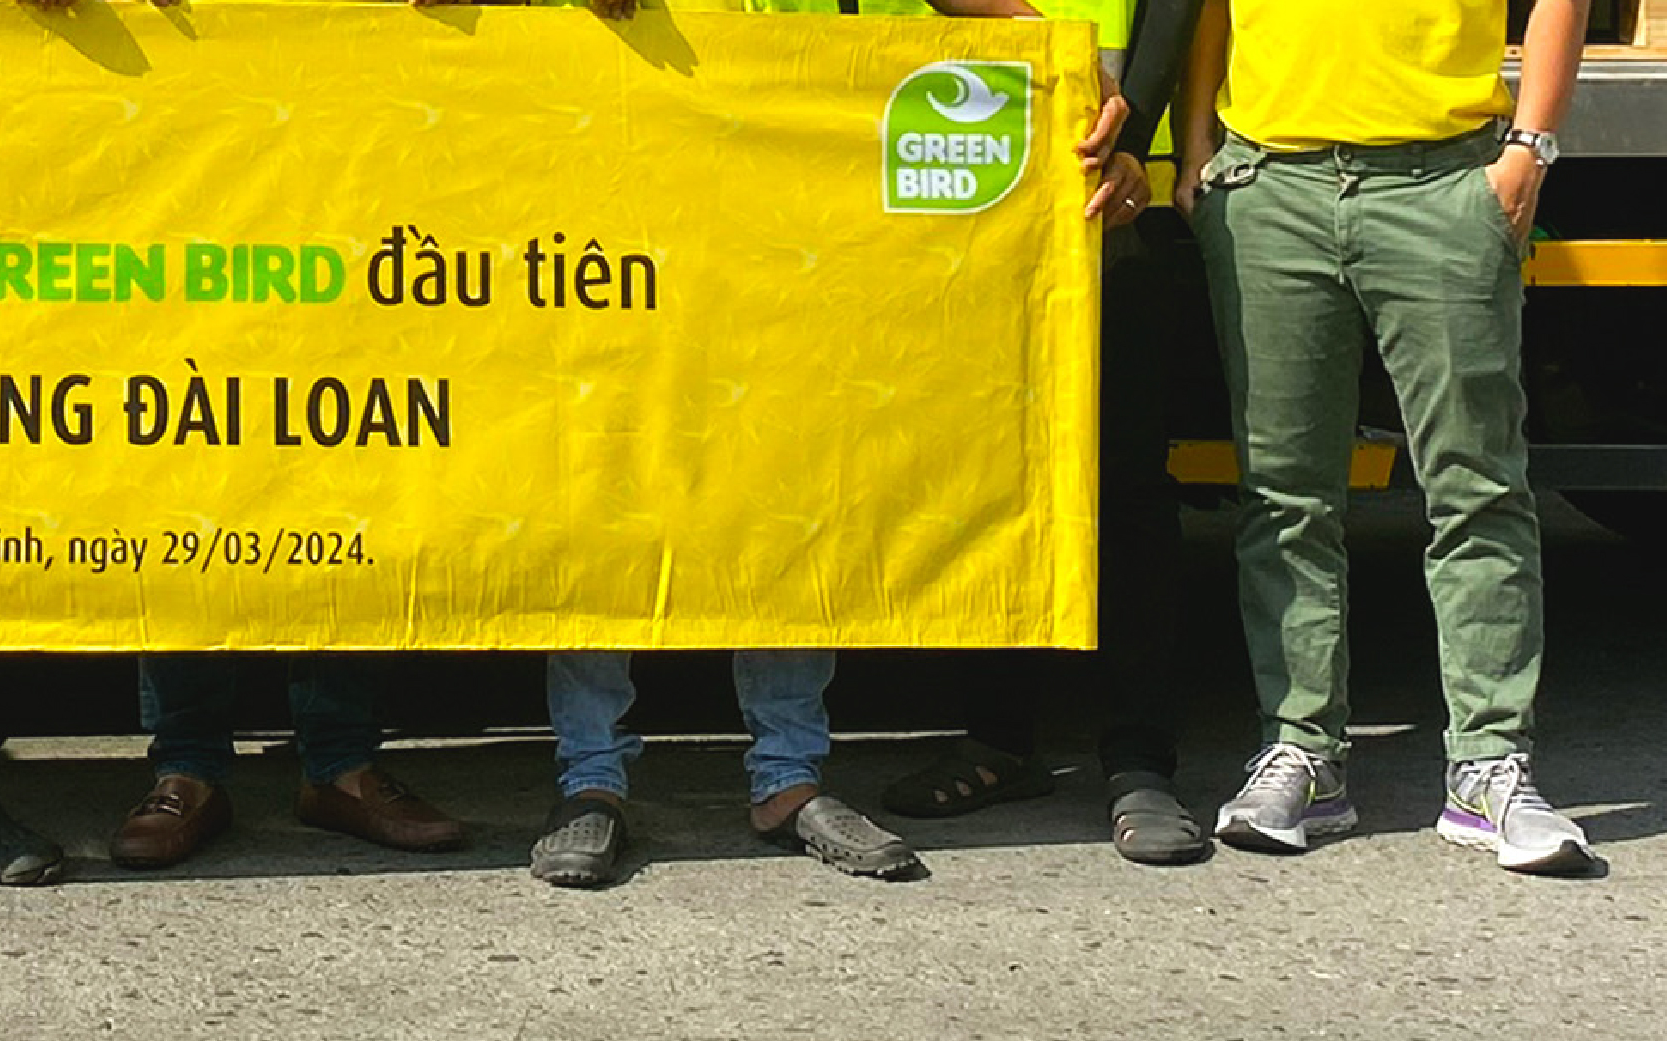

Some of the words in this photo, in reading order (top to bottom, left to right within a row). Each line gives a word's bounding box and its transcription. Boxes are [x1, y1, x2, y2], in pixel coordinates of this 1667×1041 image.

[896, 132, 1011, 165] GREEN
[896, 168, 978, 200] BIRD
[185, 242, 346, 304] BIRD
[367, 224, 492, 307] đầu
[524, 231, 657, 311] tiên
[123, 358, 240, 446] ĐÀI
[275, 376, 451, 448] LOAN
[68, 528, 148, 573] ngày
[163, 527, 375, 573] 29/03/2024.
